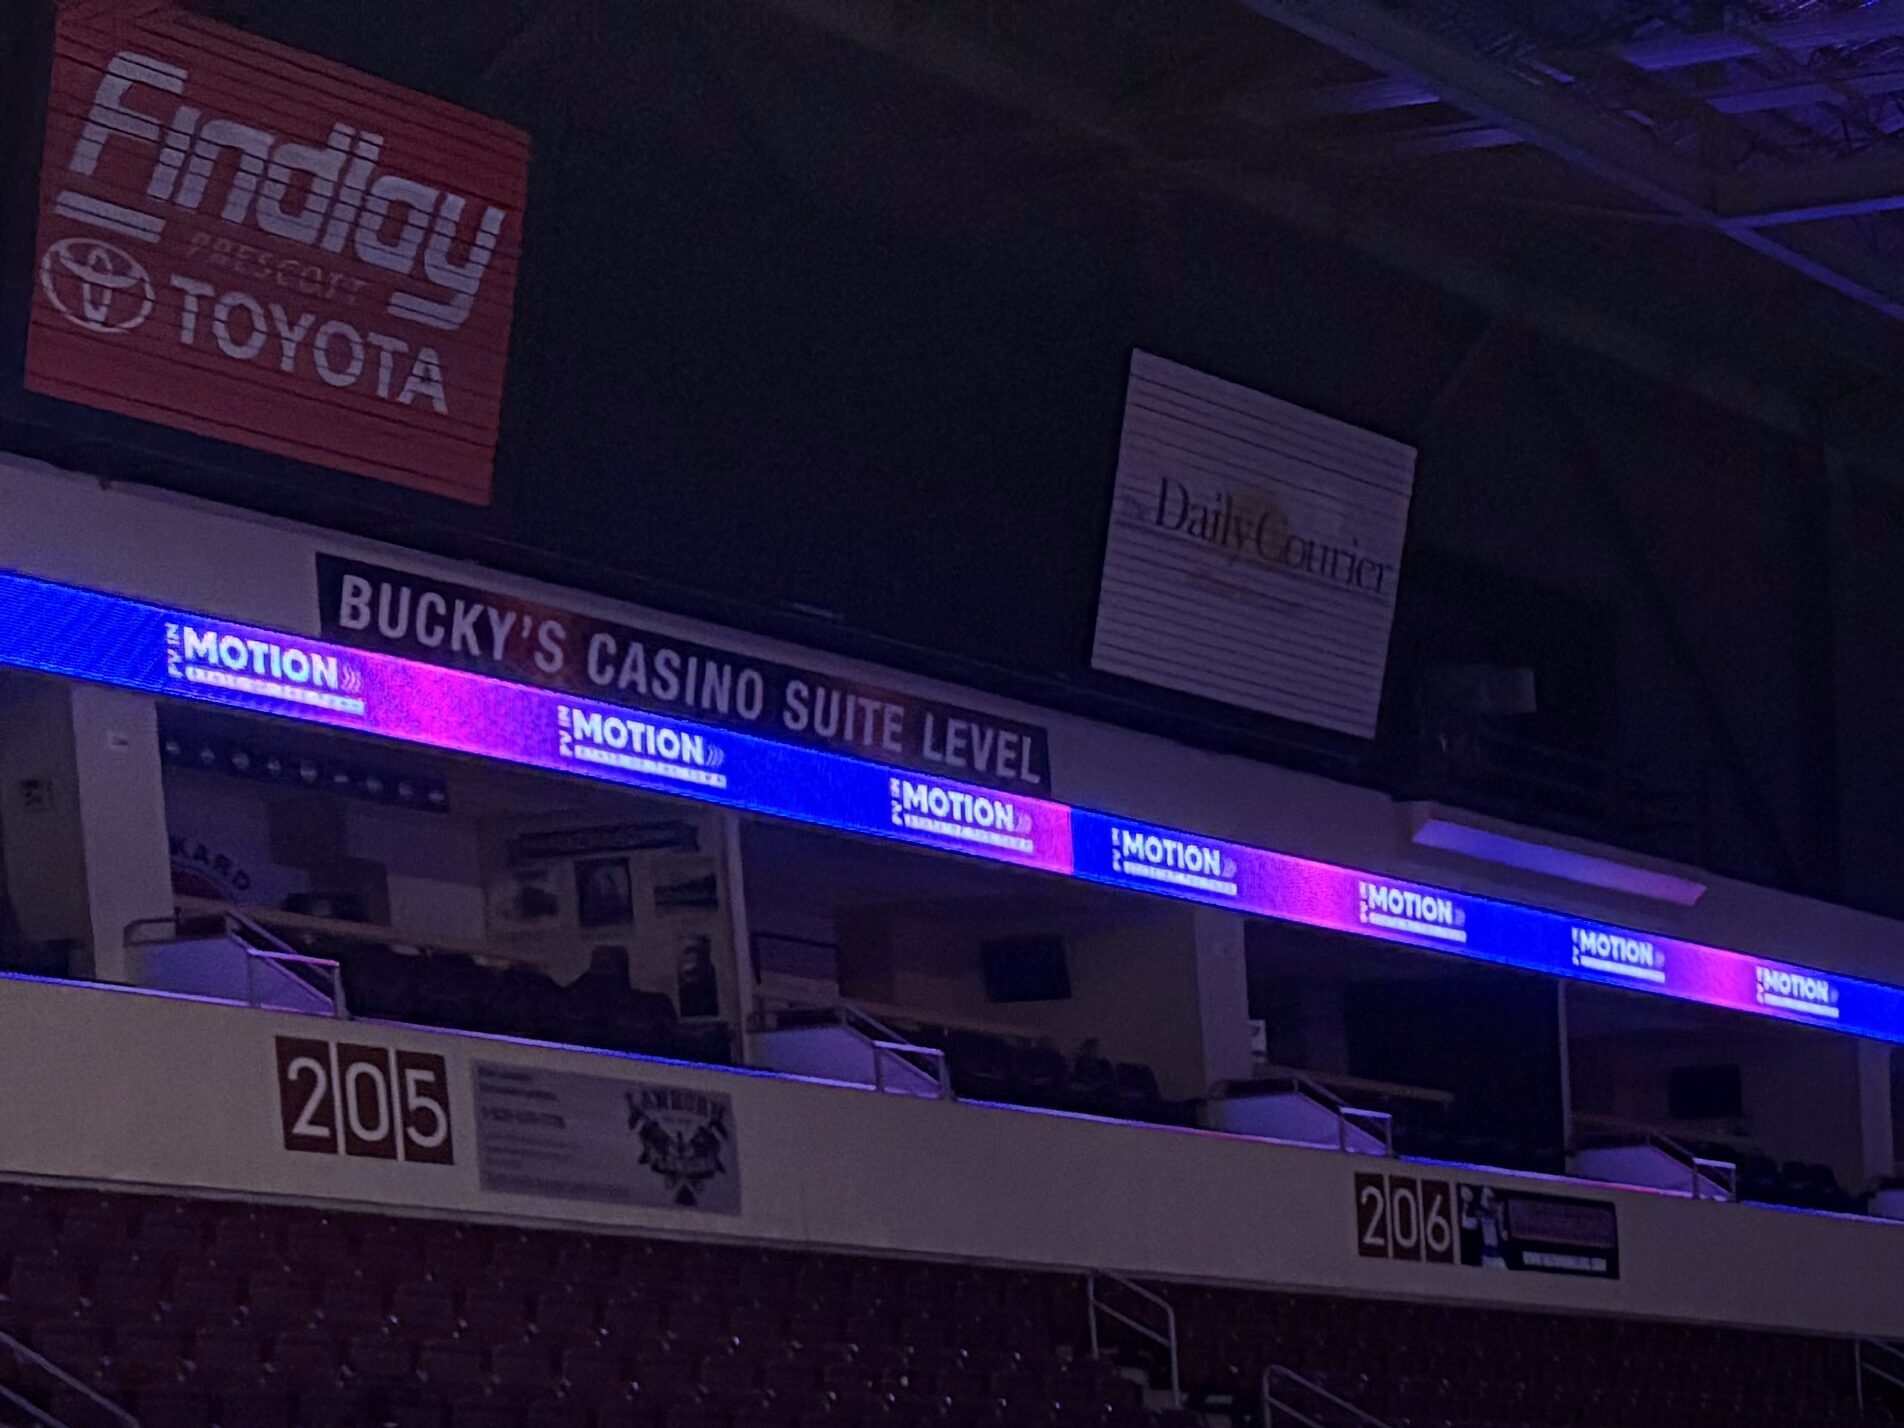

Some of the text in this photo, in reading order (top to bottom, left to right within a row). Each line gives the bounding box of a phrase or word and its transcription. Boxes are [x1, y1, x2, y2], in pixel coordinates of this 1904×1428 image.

[60, 51, 506, 330] Findlay
[170, 274, 448, 415] TOYOTA
[1153, 477, 1394, 594] Daily Courier
[183, 626, 339, 690] MOTION
[339, 574, 1041, 785] BUCKY'S CASINO SUITE LEVEL
[572, 707, 704, 766] MOTION
[902, 780, 1014, 832] MOTION
[1122, 830, 1220, 876] MOTION
[1369, 883, 1453, 925] MOTION
[1580, 929, 1653, 966] MOTION
[1763, 967, 1829, 1003] MOTION
[286, 1057, 448, 1148] 205
[1361, 1185, 1451, 1253] 206
